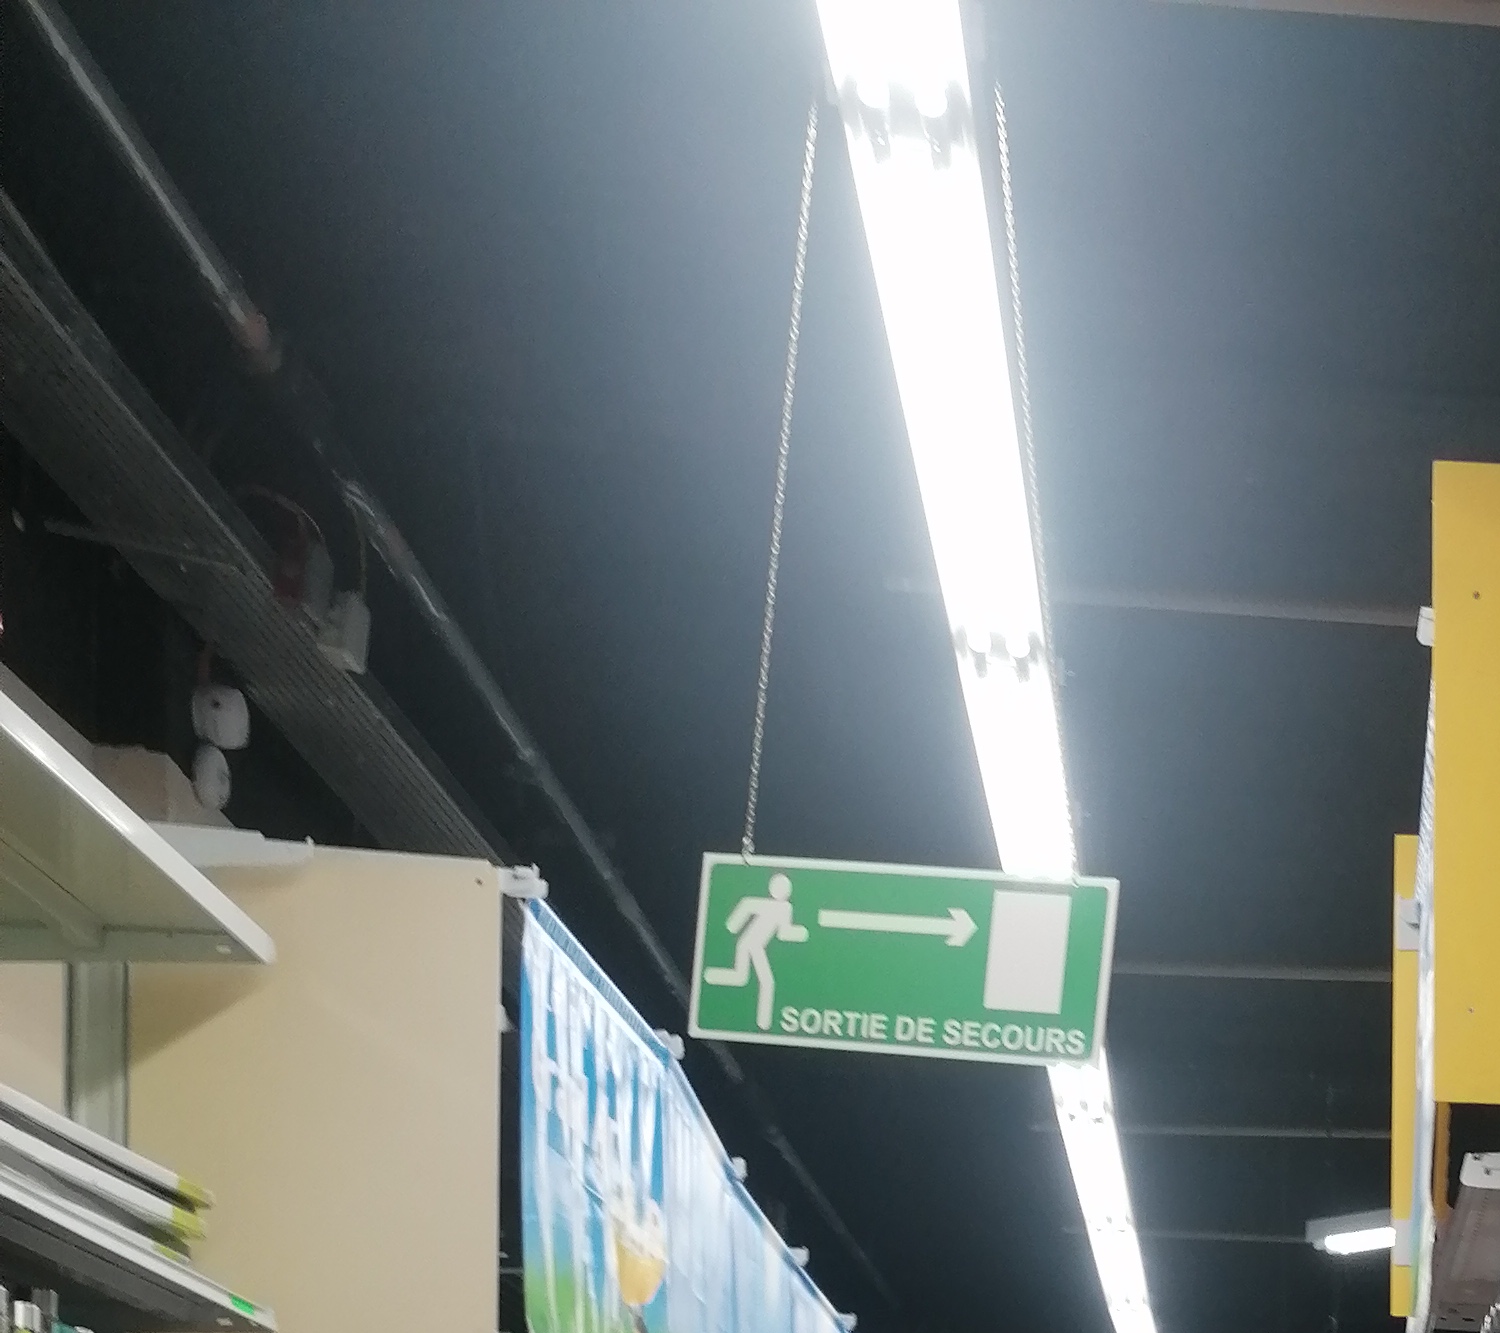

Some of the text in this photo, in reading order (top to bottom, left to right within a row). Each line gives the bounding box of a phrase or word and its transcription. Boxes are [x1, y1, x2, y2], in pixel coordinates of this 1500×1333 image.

[778, 1005, 1086, 1056] SORTIE DE SECOURS
